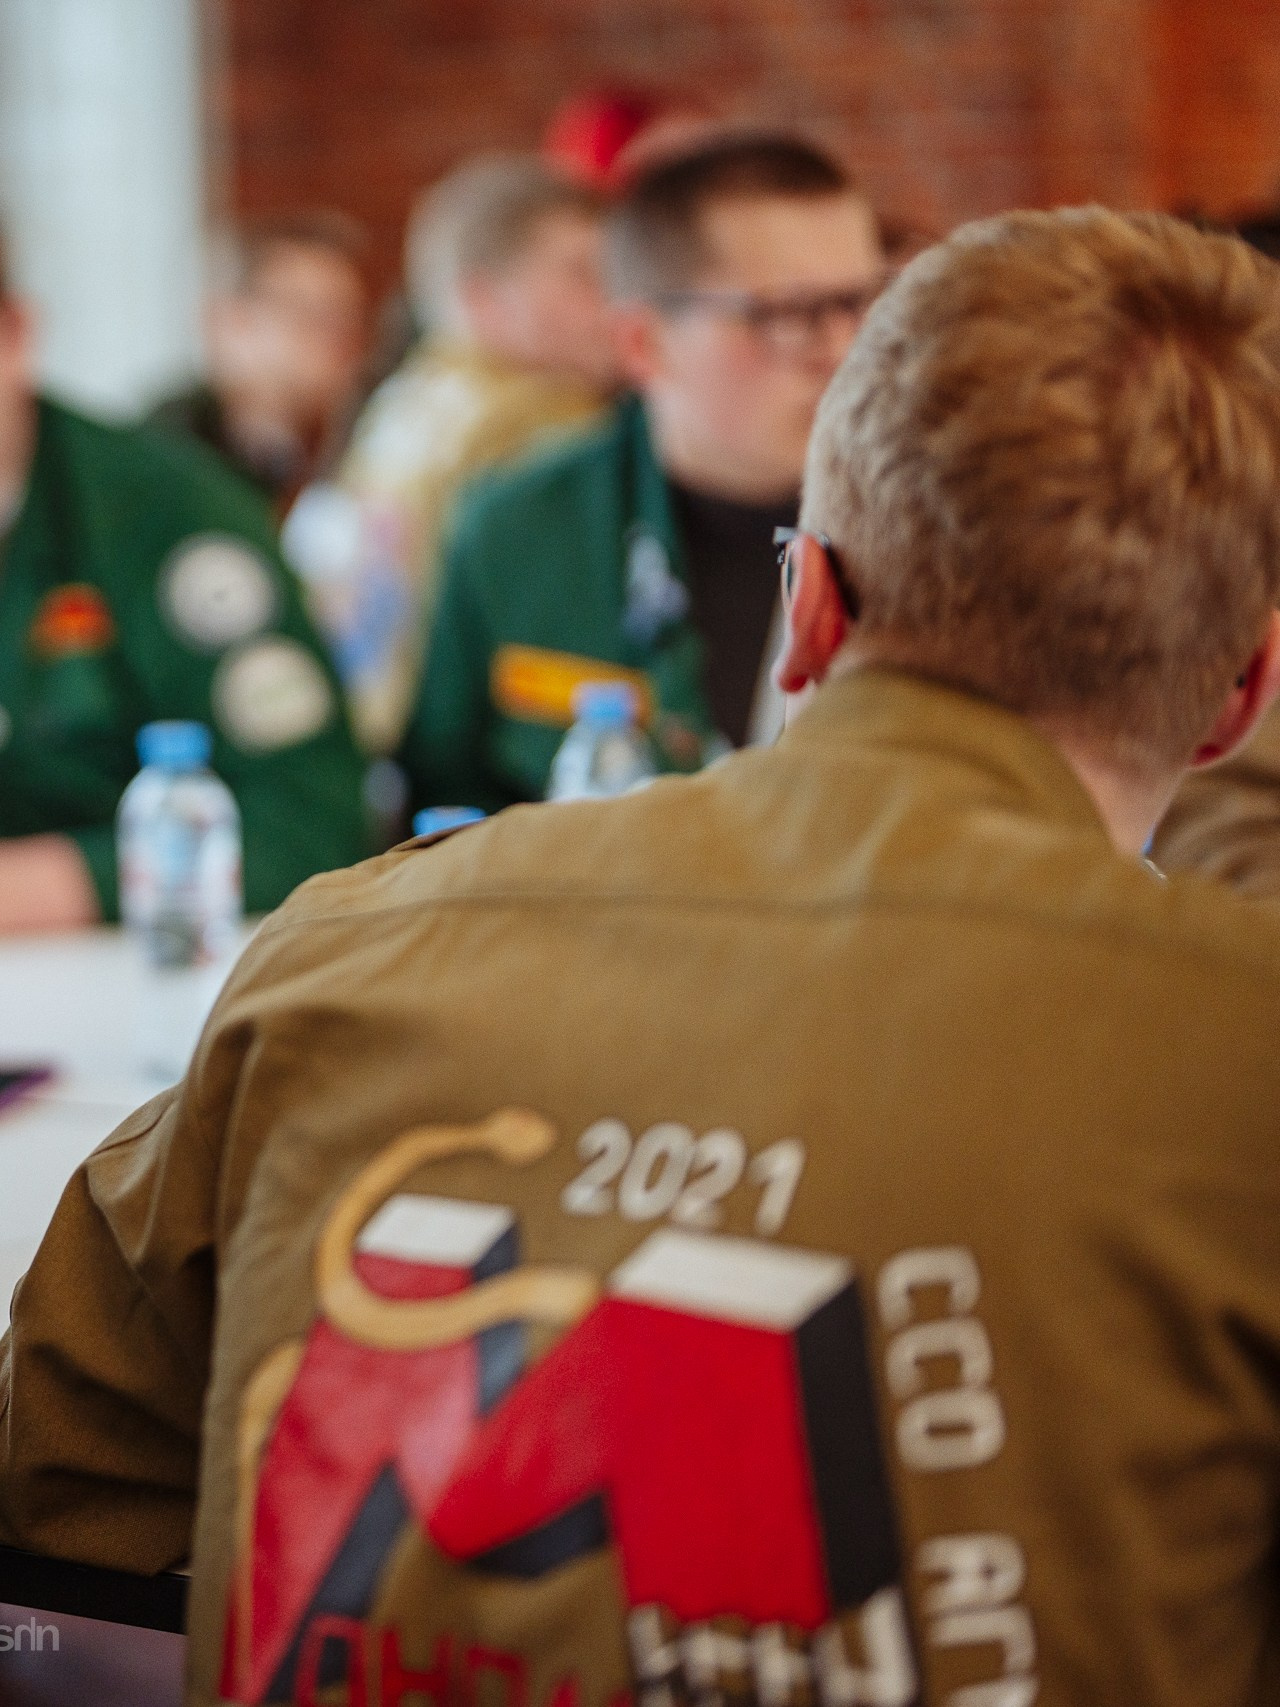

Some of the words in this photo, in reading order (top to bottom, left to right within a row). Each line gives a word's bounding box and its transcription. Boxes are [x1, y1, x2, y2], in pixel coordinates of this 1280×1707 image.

[560, 1116, 806, 1236] 2021
[877, 1247, 1007, 1472] ССО
[917, 1532, 1041, 1707] АГ
